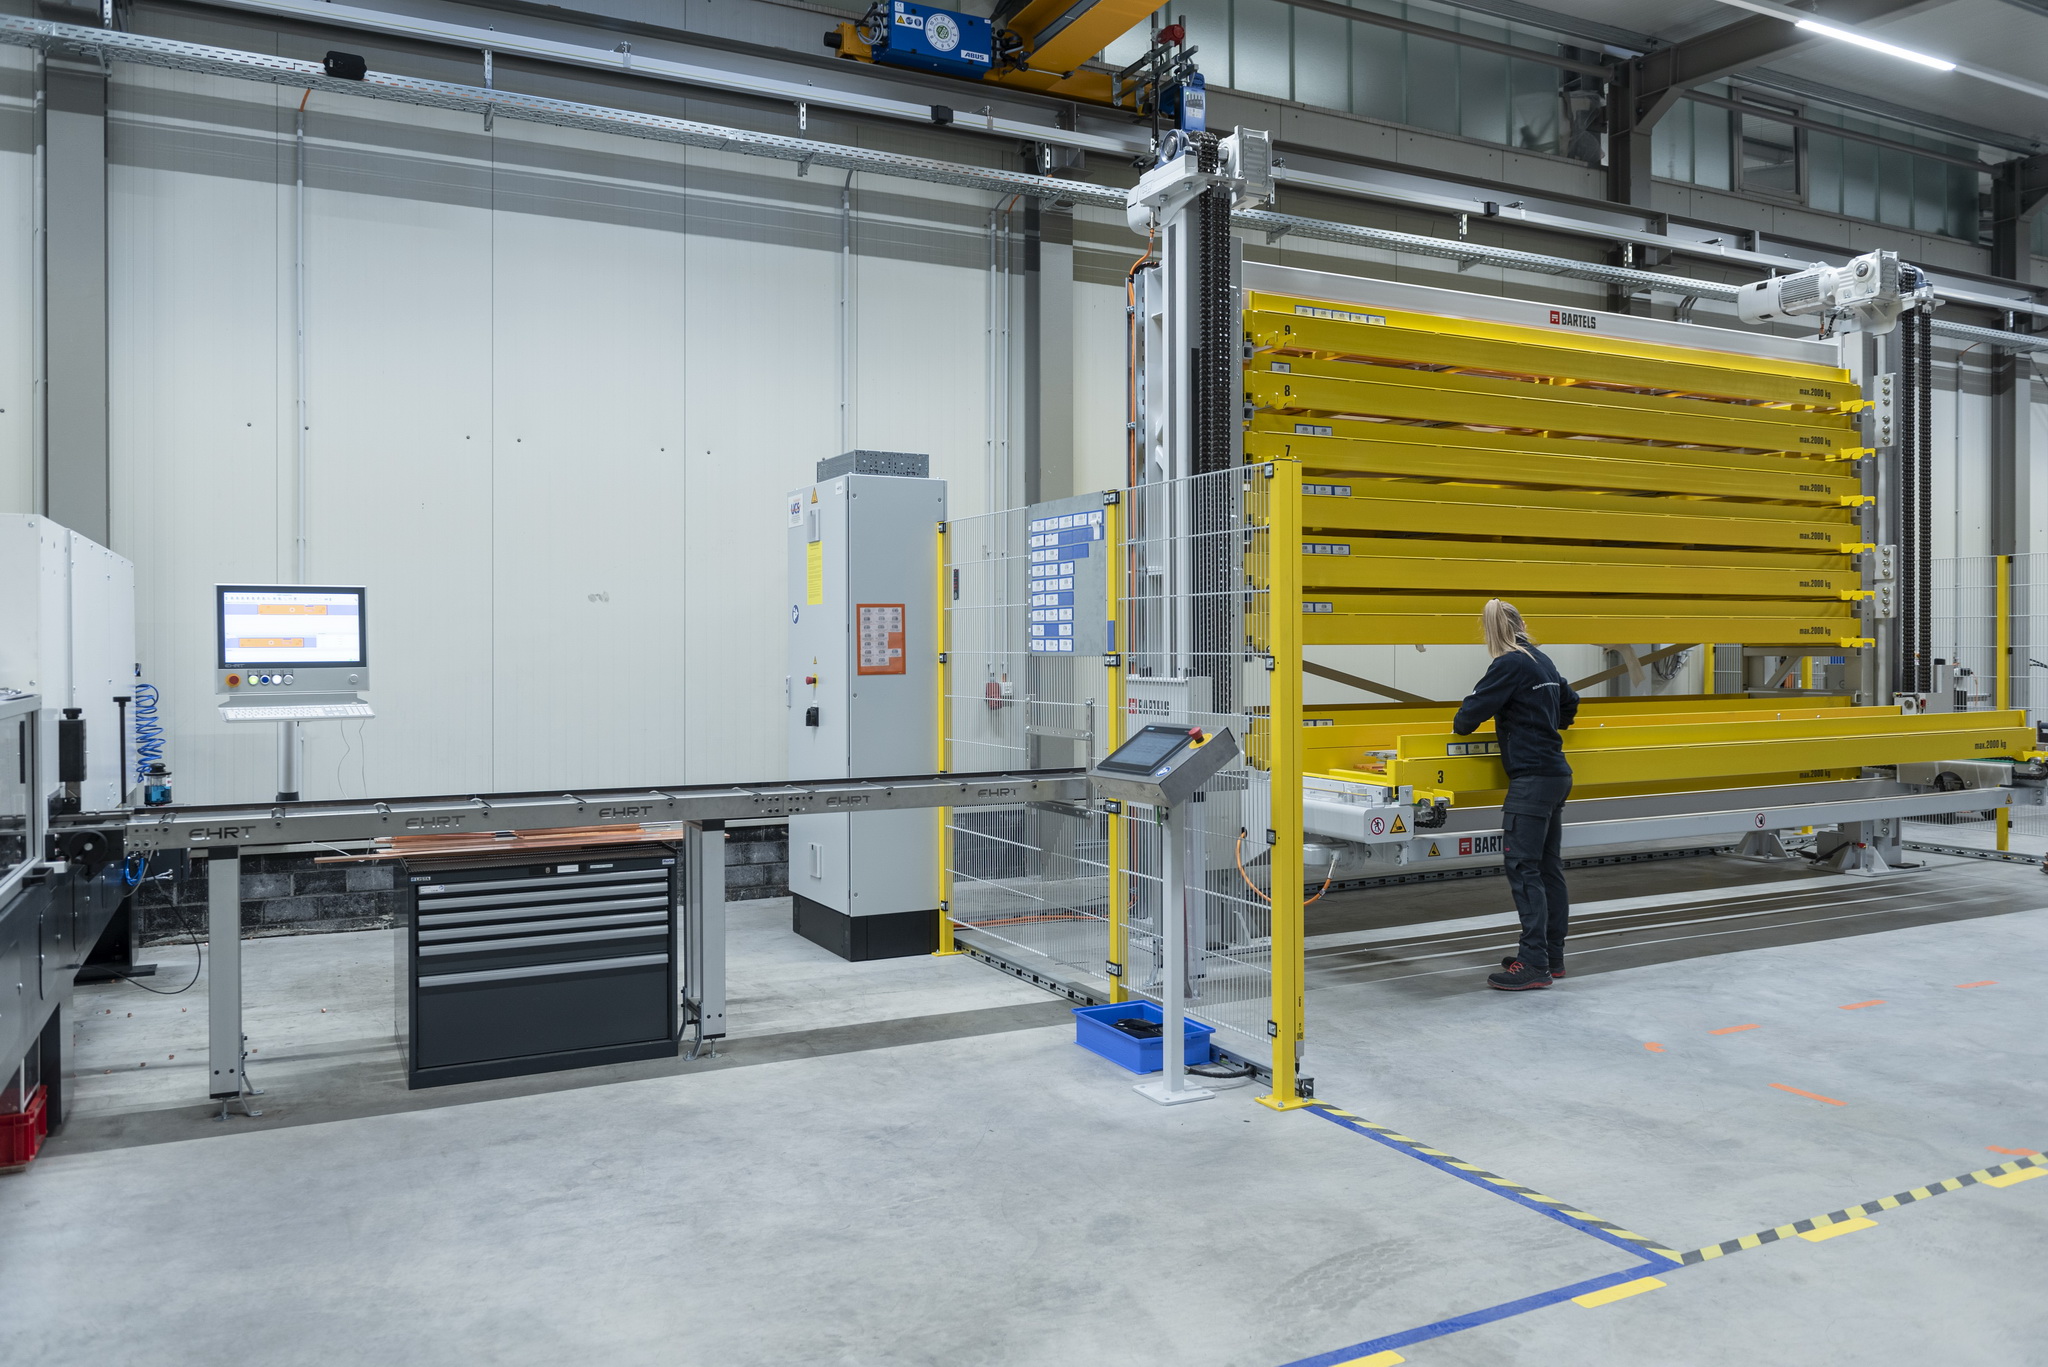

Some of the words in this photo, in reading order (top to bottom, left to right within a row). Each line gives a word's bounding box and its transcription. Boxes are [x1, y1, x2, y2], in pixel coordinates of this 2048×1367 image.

[964, 52, 985, 61] ABUS
[1561, 311, 1596, 330] BARTELS
[1284, 324, 1291, 336] 9
[1284, 384, 1291, 397] 8
[1285, 444, 1291, 456] 7
[1974, 740, 2000, 750] max.2000
[2000, 740, 2006, 750] kg
[1437, 770, 1444, 784] 3
[978, 788, 1021, 798] EHRT
[826, 795, 871, 808] EHRT
[598, 806, 653, 819] EHRT
[405, 815, 466, 829] EHRT
[188, 825, 256, 840] EHRT
